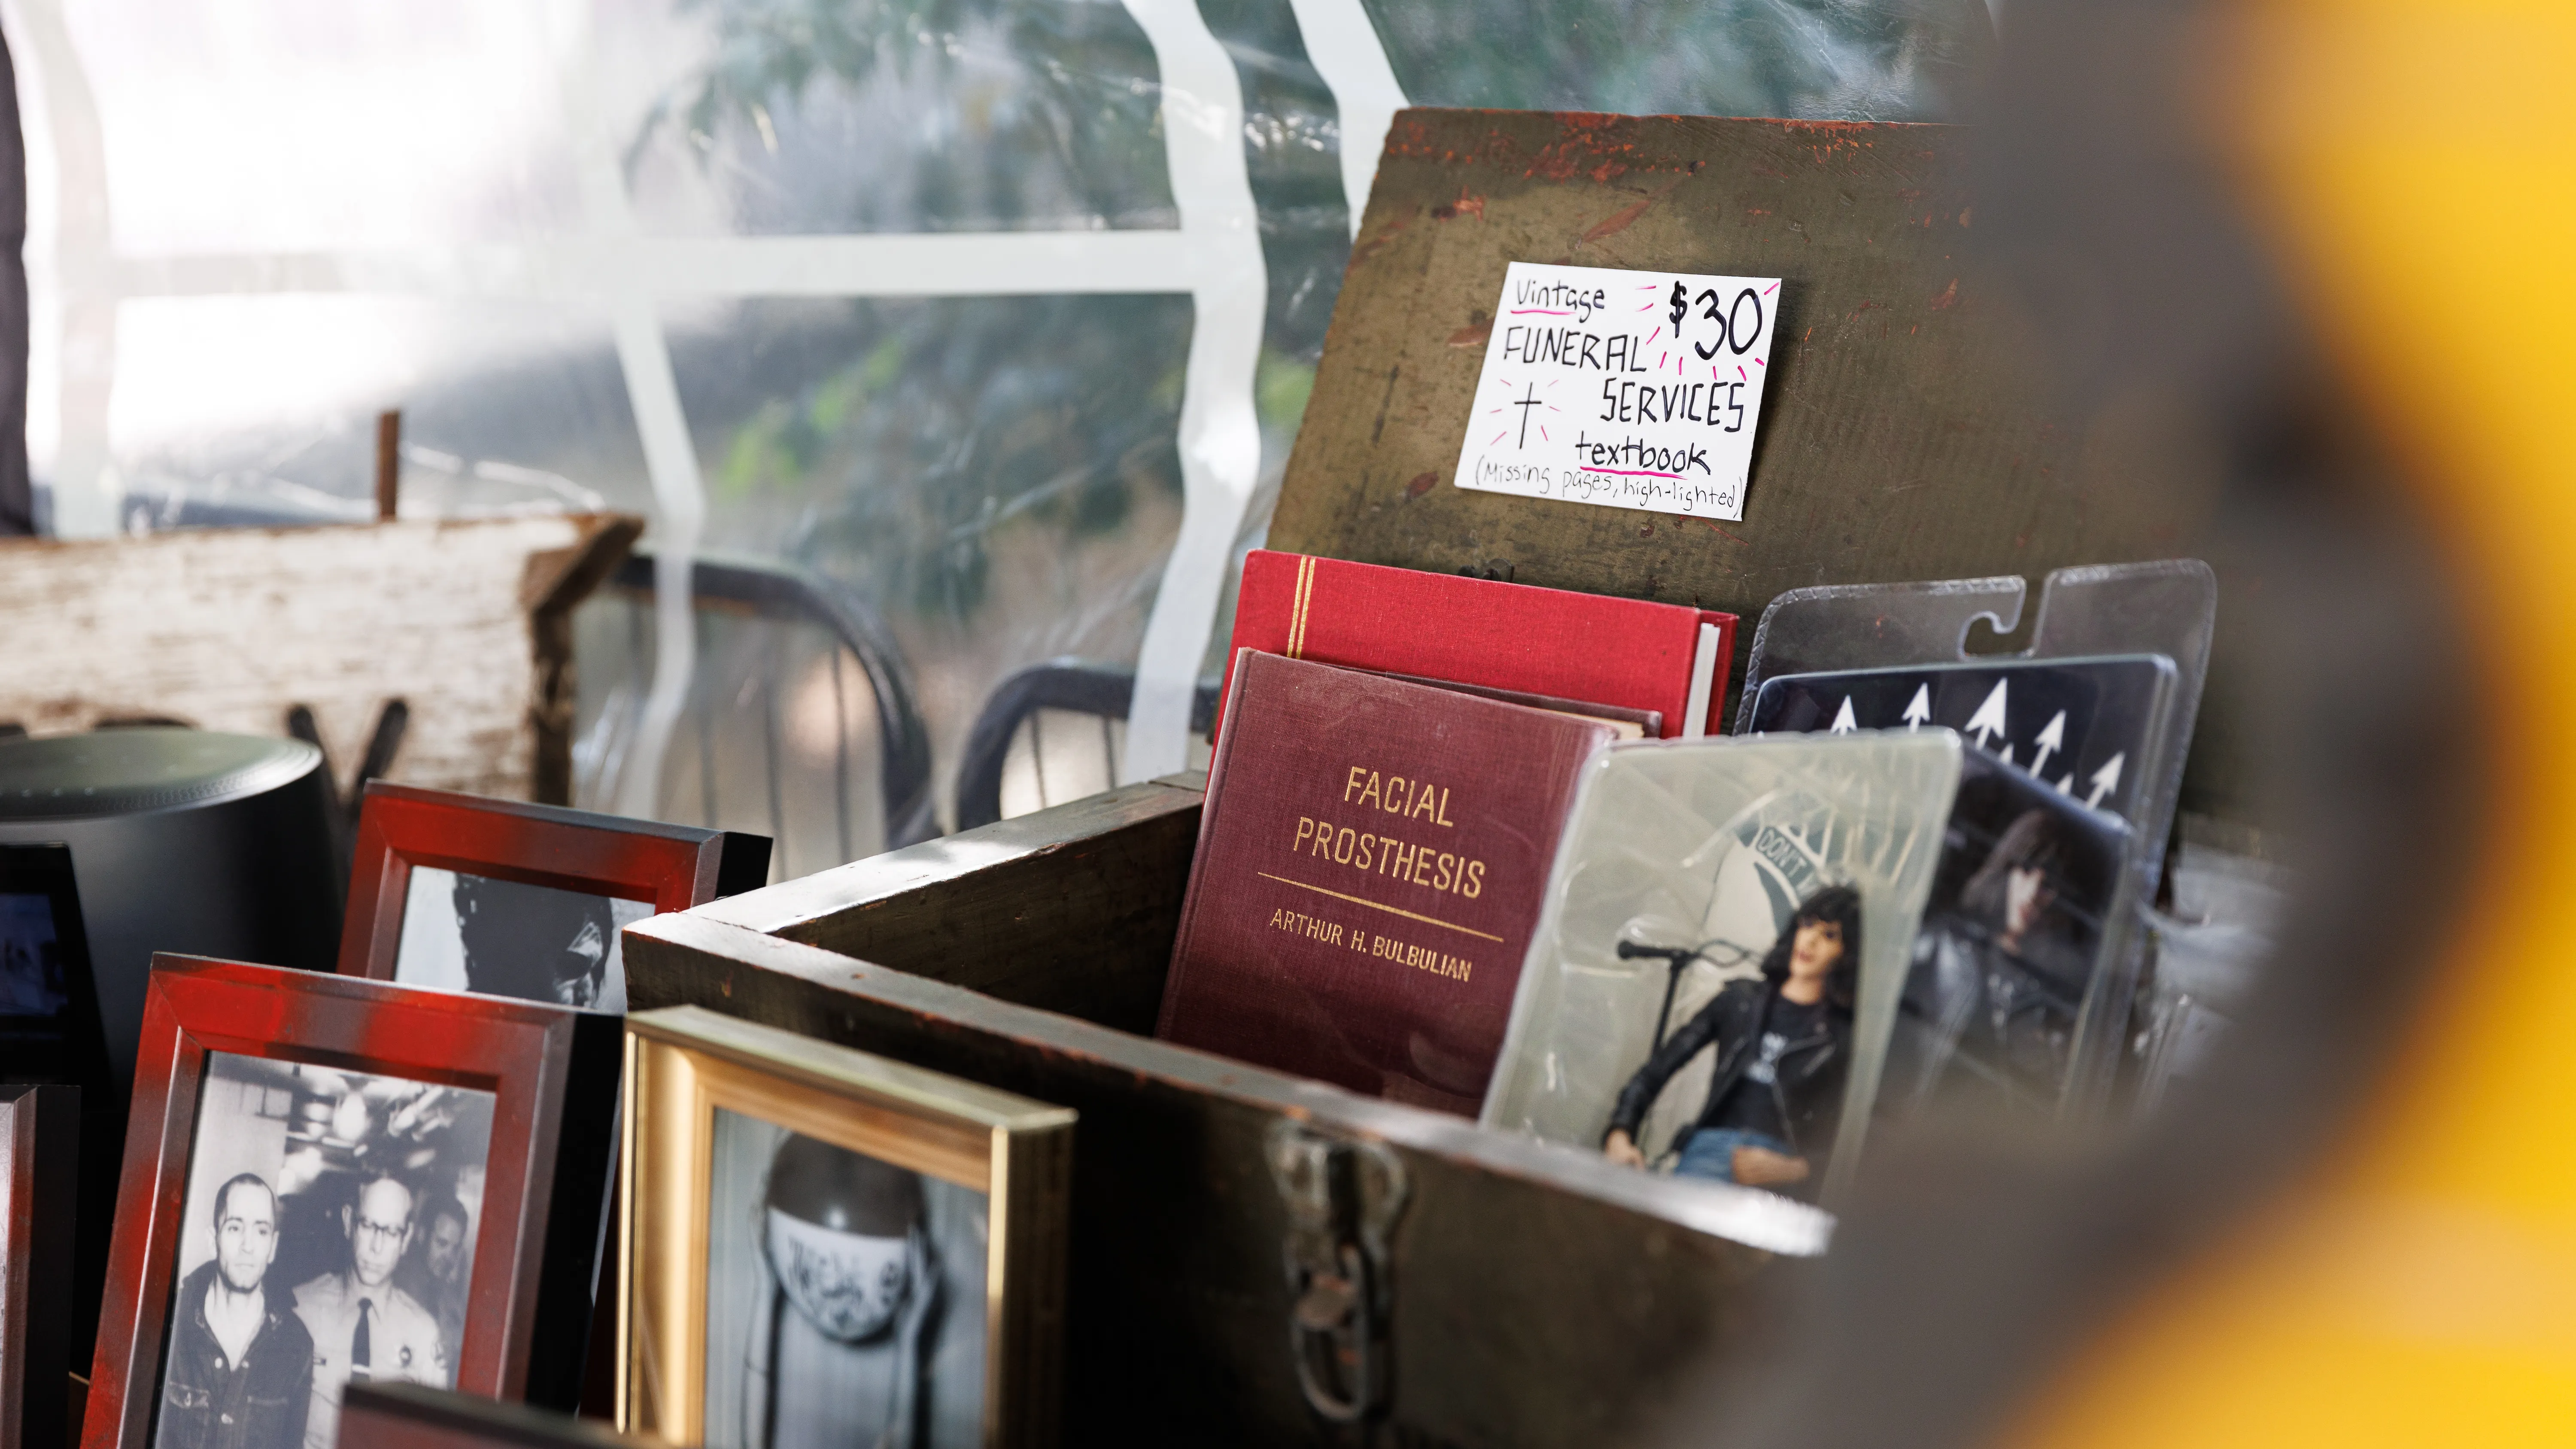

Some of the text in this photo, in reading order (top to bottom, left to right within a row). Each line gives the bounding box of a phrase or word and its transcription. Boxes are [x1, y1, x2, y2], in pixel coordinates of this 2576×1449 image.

[1517, 279, 1605, 323] Vintage
[1669, 280, 1763, 360] $30
[1504, 326, 1647, 372] FUNERAL
[1600, 377, 1745, 433] SERVICES
[1575, 430, 1711, 475] textbook
[1475, 454, 1742, 519] (Missing pages, high-lighted)
[1345, 766, 1453, 827] FACIAL
[1293, 816, 1485, 899] PROSTHESIS
[1269, 908, 1472, 983] ARTHUR H. BULBULIAN
